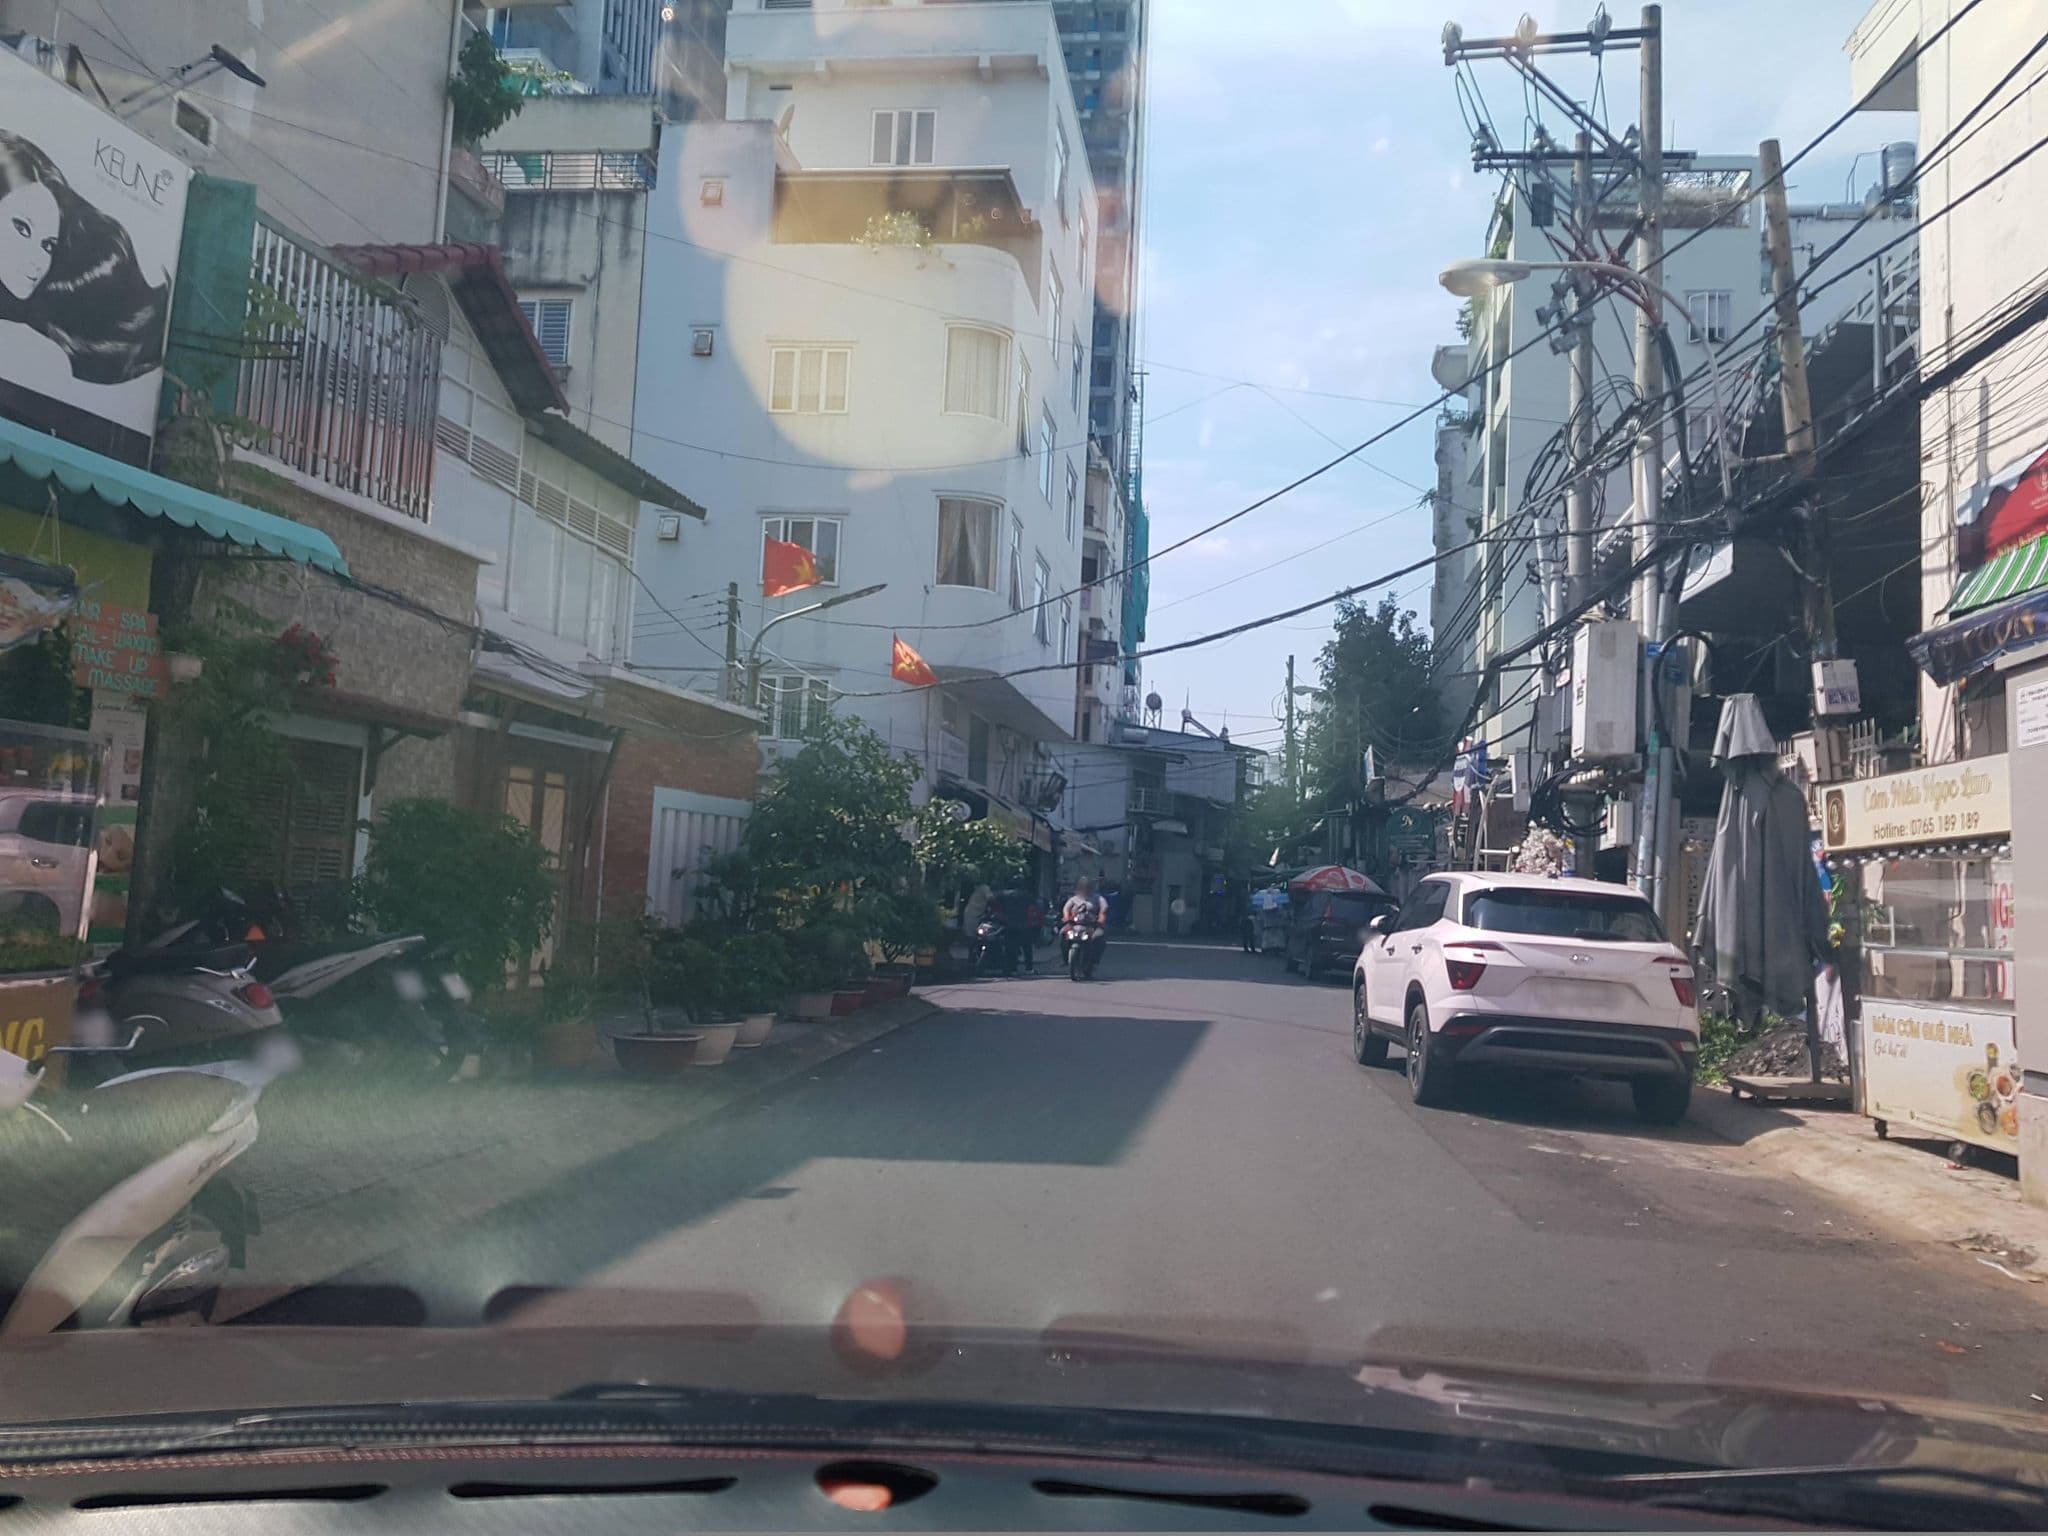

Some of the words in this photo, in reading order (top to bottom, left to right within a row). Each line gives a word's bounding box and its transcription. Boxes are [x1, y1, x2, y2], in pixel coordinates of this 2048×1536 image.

[94, 137, 165, 205] KEUNE
[72, 642, 115, 669] MAKE
[128, 655, 149, 674] UP
[88, 667, 159, 694] MASSAGE
[1873, 823, 1909, 841] Hotline:
[1910, 815, 1936, 836] 0765
[1938, 813, 1958, 833] 189
[1960, 811, 1981, 832] 189
